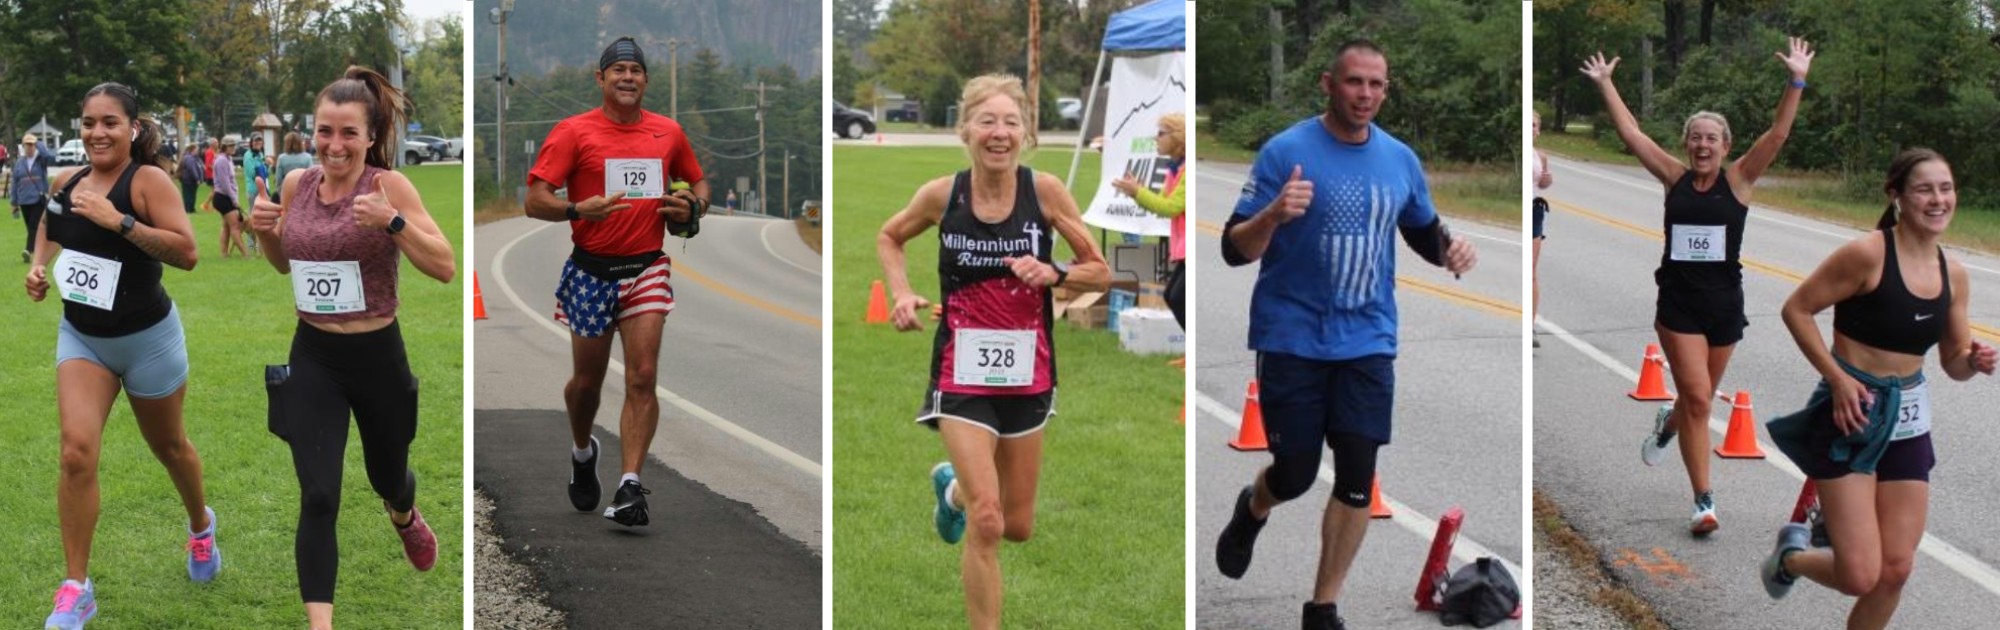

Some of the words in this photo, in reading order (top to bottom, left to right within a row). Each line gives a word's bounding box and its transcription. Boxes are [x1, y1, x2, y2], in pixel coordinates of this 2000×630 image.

[624, 171, 647, 186] 129
[942, 232, 1031, 252] Millennium
[1688, 237, 1710, 250] 166
[65, 266, 99, 290] 206
[306, 278, 341, 297] 207
[977, 347, 1016, 368] 328
[1897, 403, 1920, 424] 32
